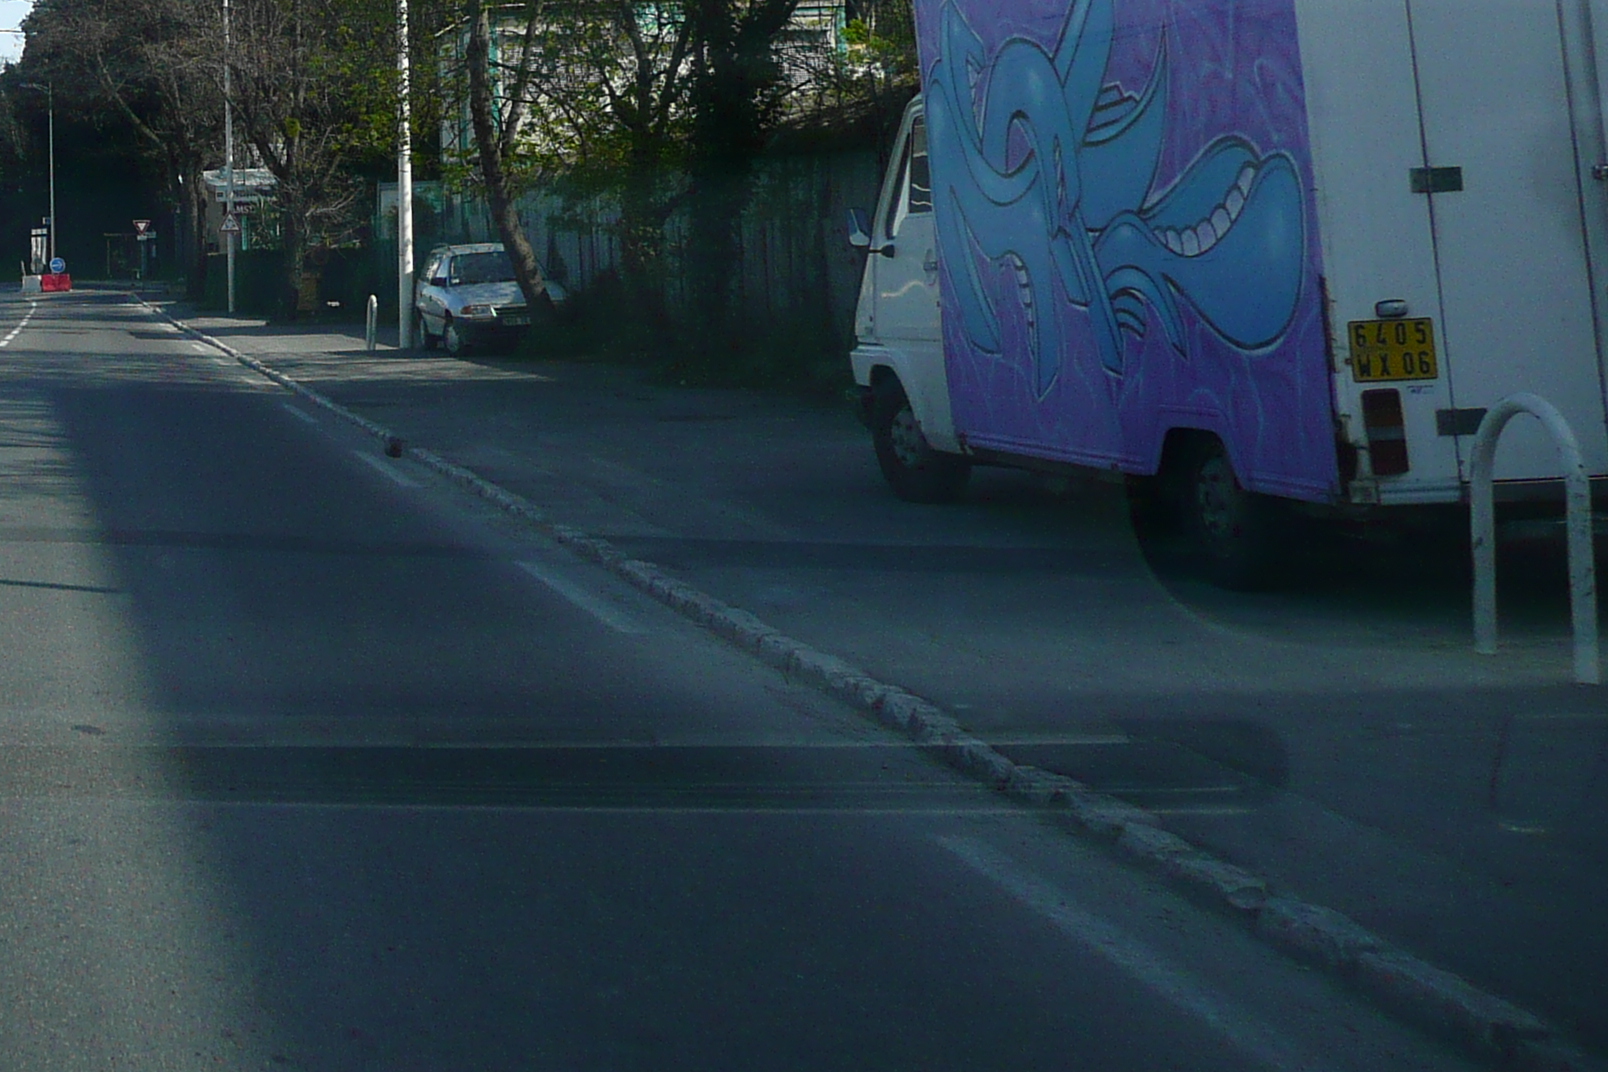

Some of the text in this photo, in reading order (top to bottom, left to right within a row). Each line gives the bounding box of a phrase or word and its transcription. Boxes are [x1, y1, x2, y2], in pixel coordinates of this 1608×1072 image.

[1354, 321, 1427, 348] 6405
[1357, 350, 1431, 377] WX 06
